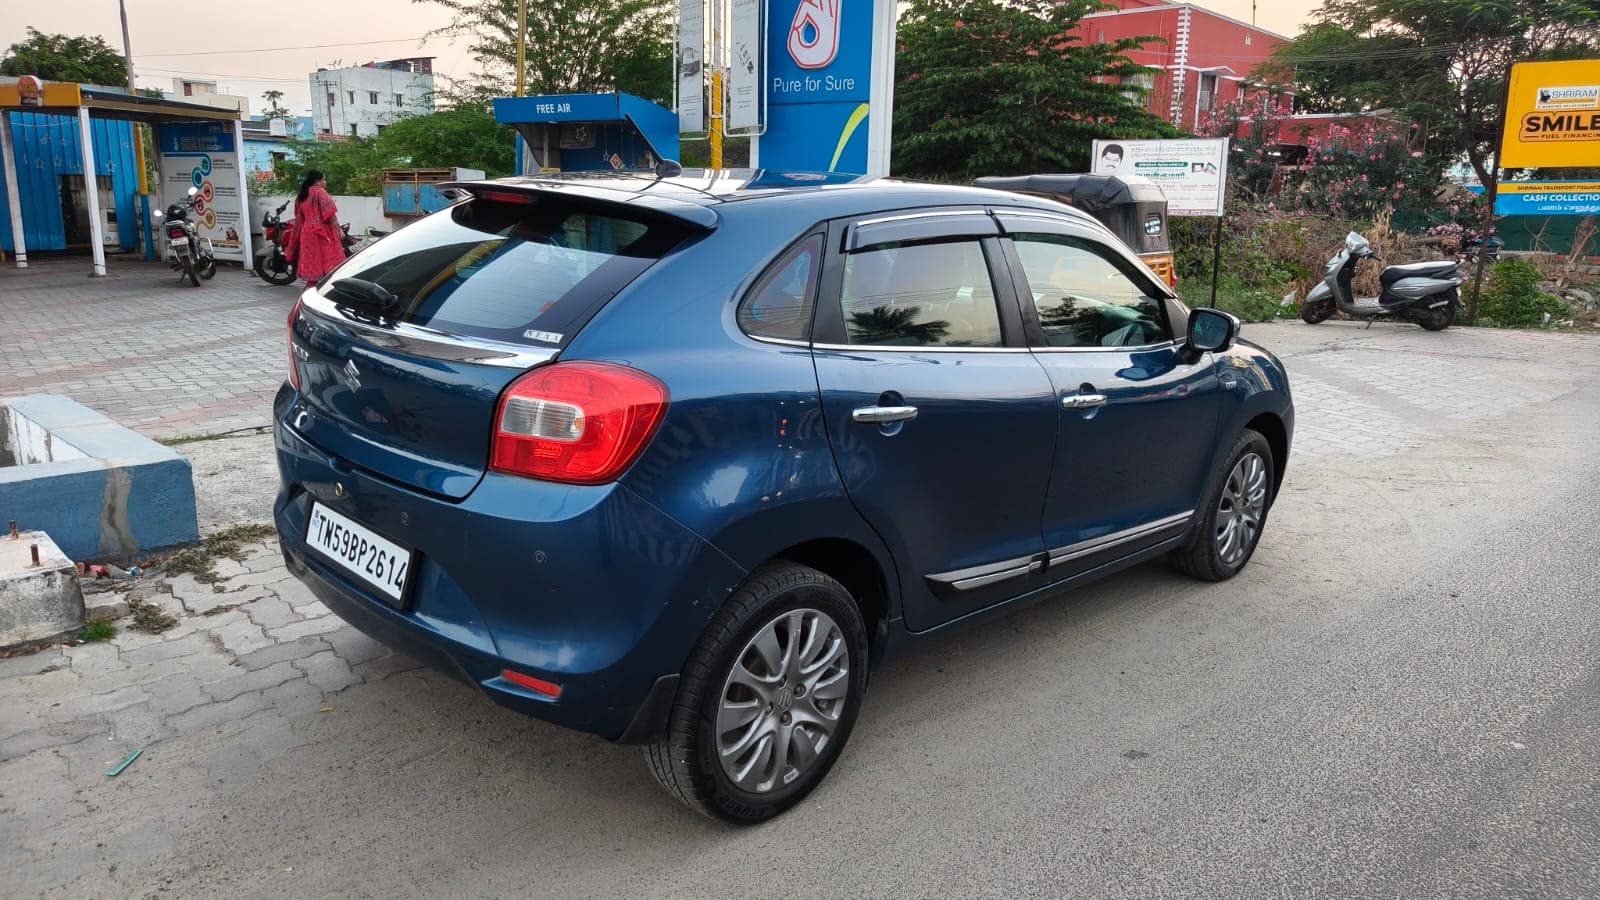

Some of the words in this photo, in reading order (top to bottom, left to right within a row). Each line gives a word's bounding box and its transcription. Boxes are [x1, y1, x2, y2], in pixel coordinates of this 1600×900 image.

[774, 78, 801, 92] Pure
[806, 76, 822, 91] for
[825, 75, 855, 91] Sure
[1552, 89, 1598, 98] SHRIRAM
[536, 104, 555, 114] FREE
[557, 103, 572, 113] AIR
[1525, 115, 1600, 132] SMILE
[1523, 194, 1548, 202] CASH
[317, 514, 407, 592] TN59BP2614
